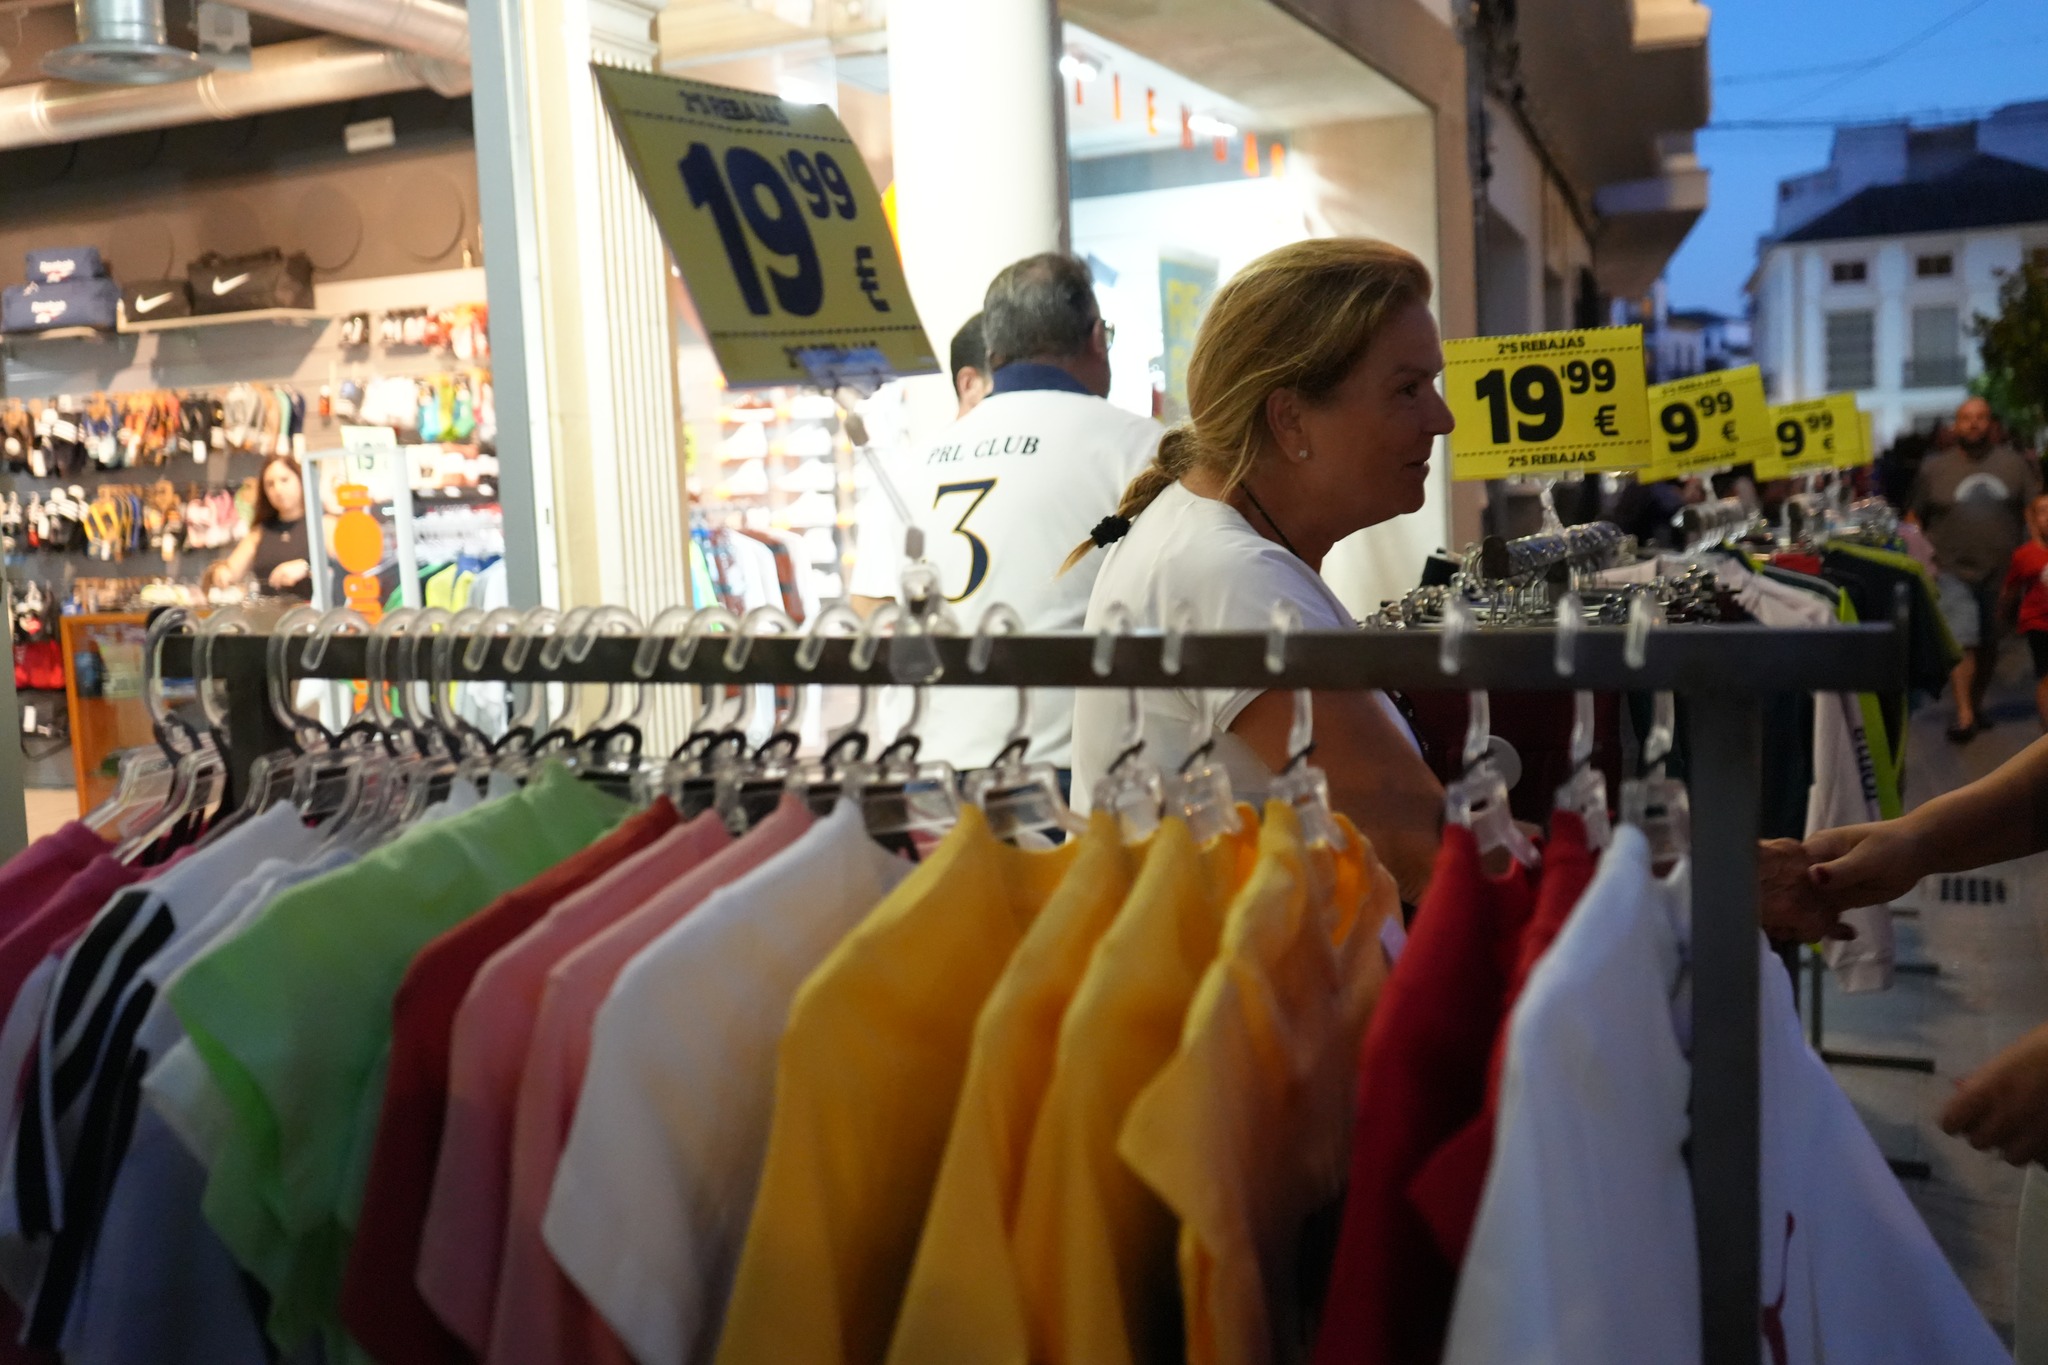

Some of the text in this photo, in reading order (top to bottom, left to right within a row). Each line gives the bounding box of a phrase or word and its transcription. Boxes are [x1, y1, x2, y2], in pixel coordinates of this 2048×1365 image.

[856, 246, 890, 312] €
[1521, 336, 1586, 352] REBAJAS
[1594, 404, 1619, 436] €
[1721, 420, 1739, 442] €
[927, 434, 1040, 465] PRL CLUB
[1531, 450, 1597, 466] REBAJAS
[932, 476, 999, 605] 3
